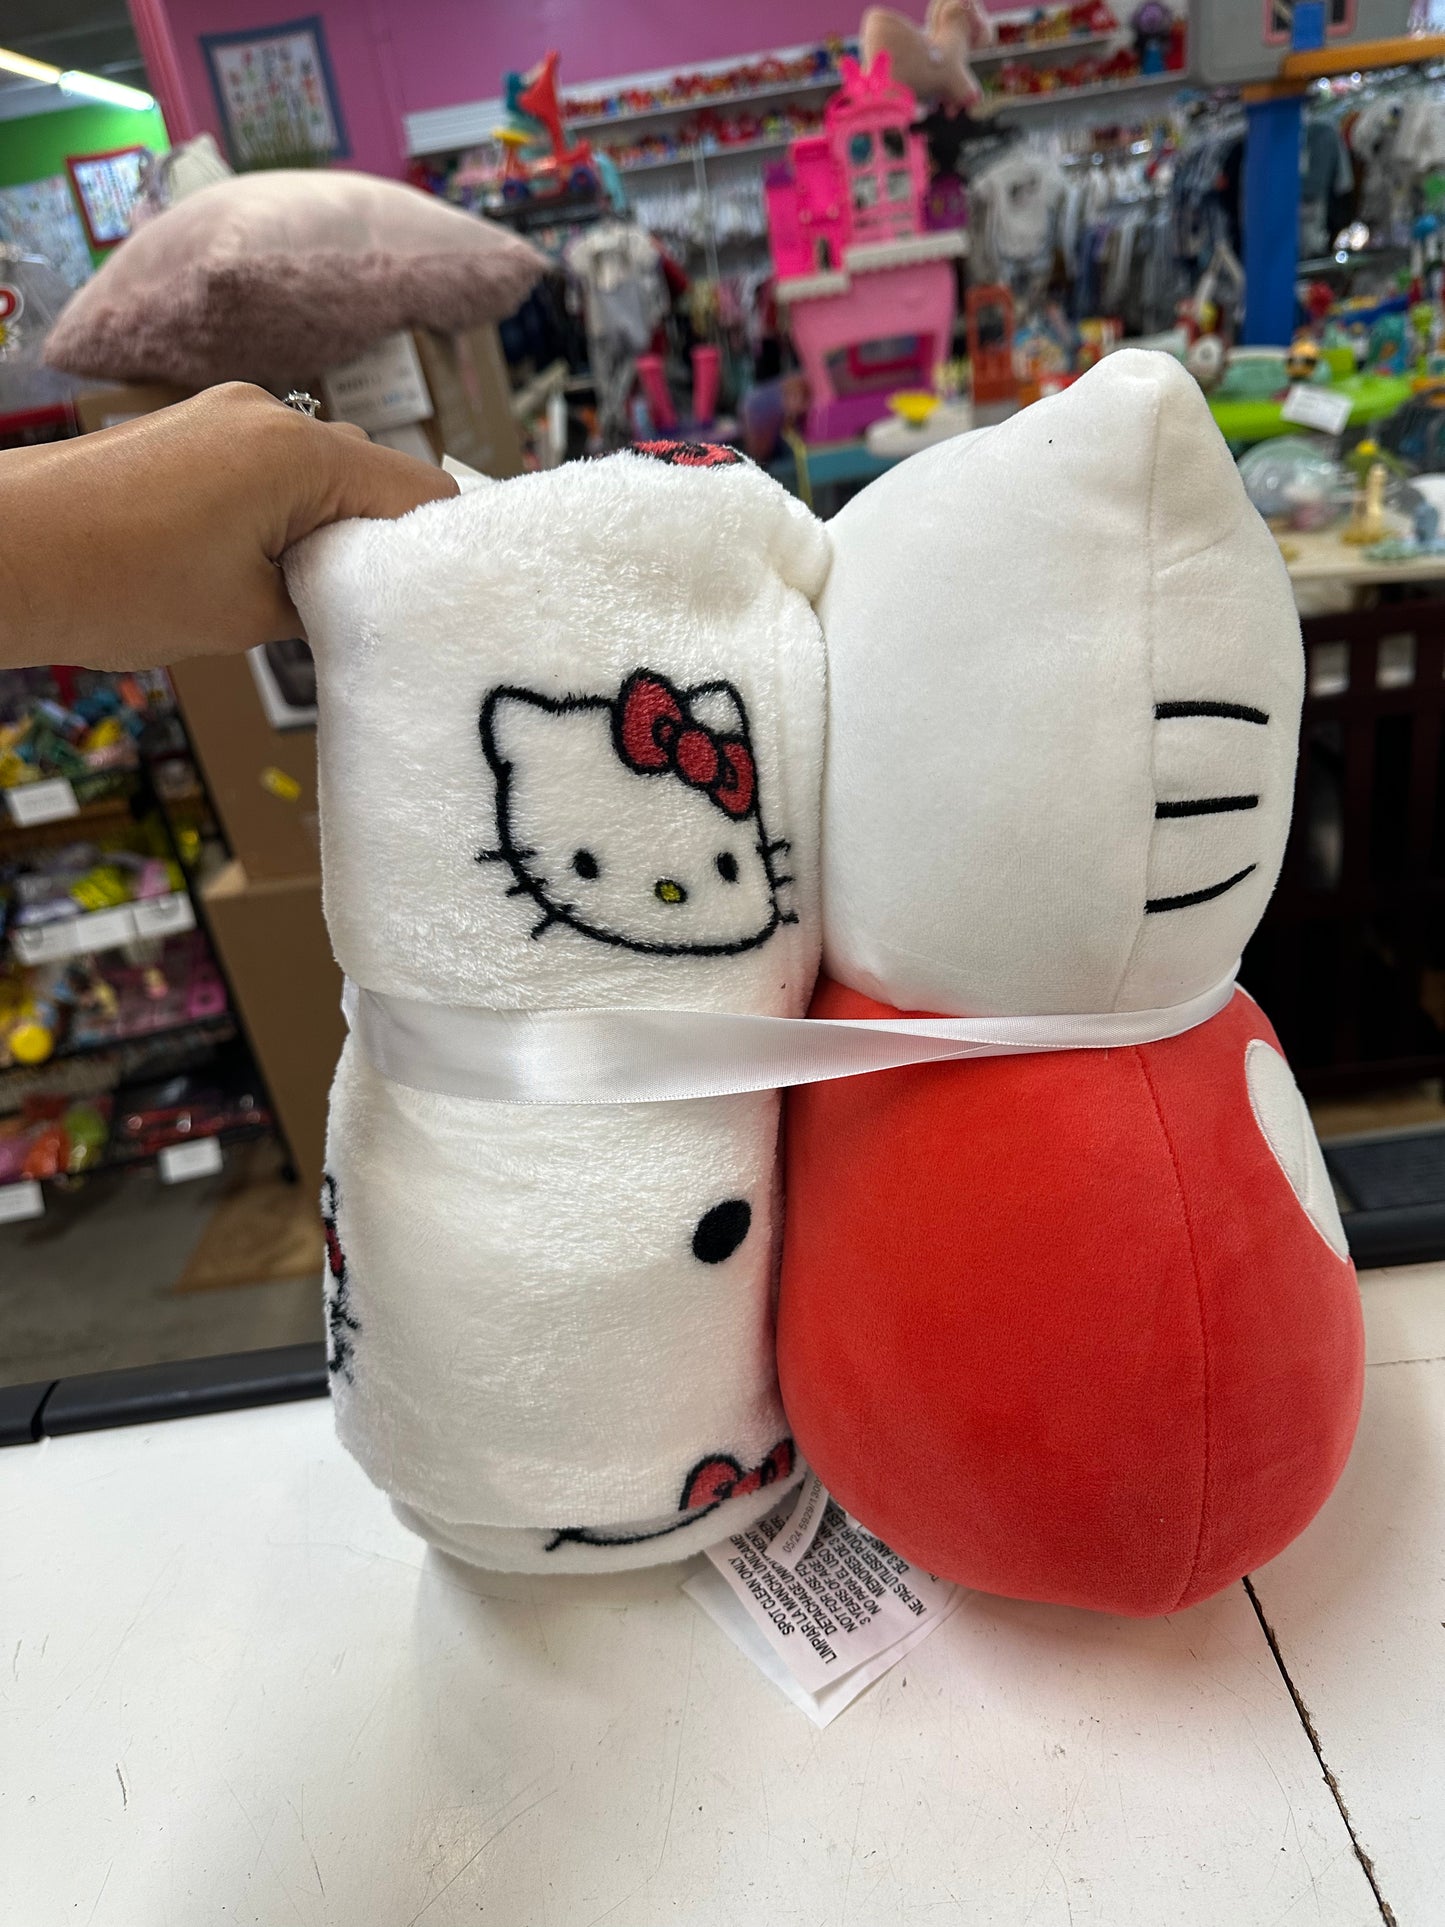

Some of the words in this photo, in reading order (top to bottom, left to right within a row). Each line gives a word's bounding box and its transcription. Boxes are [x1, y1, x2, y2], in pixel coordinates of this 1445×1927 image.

[826, 1512, 847, 1530] LES
[827, 1535, 841, 1546] 3
[831, 1542, 851, 1557] DE
[839, 1527, 867, 1553] POUR
[870, 1539, 894, 1556] ANS
[727, 1556, 753, 1580] ONLY
[793, 1559, 811, 1577] FO
[807, 1558, 831, 1576] AGE
[816, 1547, 840, 1568] USO
[860, 1549, 899, 1587] UTILISER
[885, 1554, 899, 1565] 3
[891, 1559, 910, 1575] DE
[834, 1564, 850, 1579] EL
[842, 1554, 886, 1597] MENORES
[745, 1576, 776, 1610] CLEAN
[760, 1569, 798, 1612] MANCHA
[803, 1574, 826, 1595] USE
[822, 1577, 841, 1590] OF
[843, 1575, 869, 1601] PARA
[892, 1581, 915, 1603] PAS
[819, 1591, 842, 1613] FOR
[833, 1587, 864, 1619] YEARS
[862, 1598, 882, 1614] NO
[907, 1598, 927, 1616] NE
[767, 1608, 795, 1636] SPOT
[790, 1607, 808, 1624] LA
[833, 1611, 858, 1633] NOT
[857, 1615, 872, 1626] 3
[799, 1620, 837, 1664] LIMPIAR
